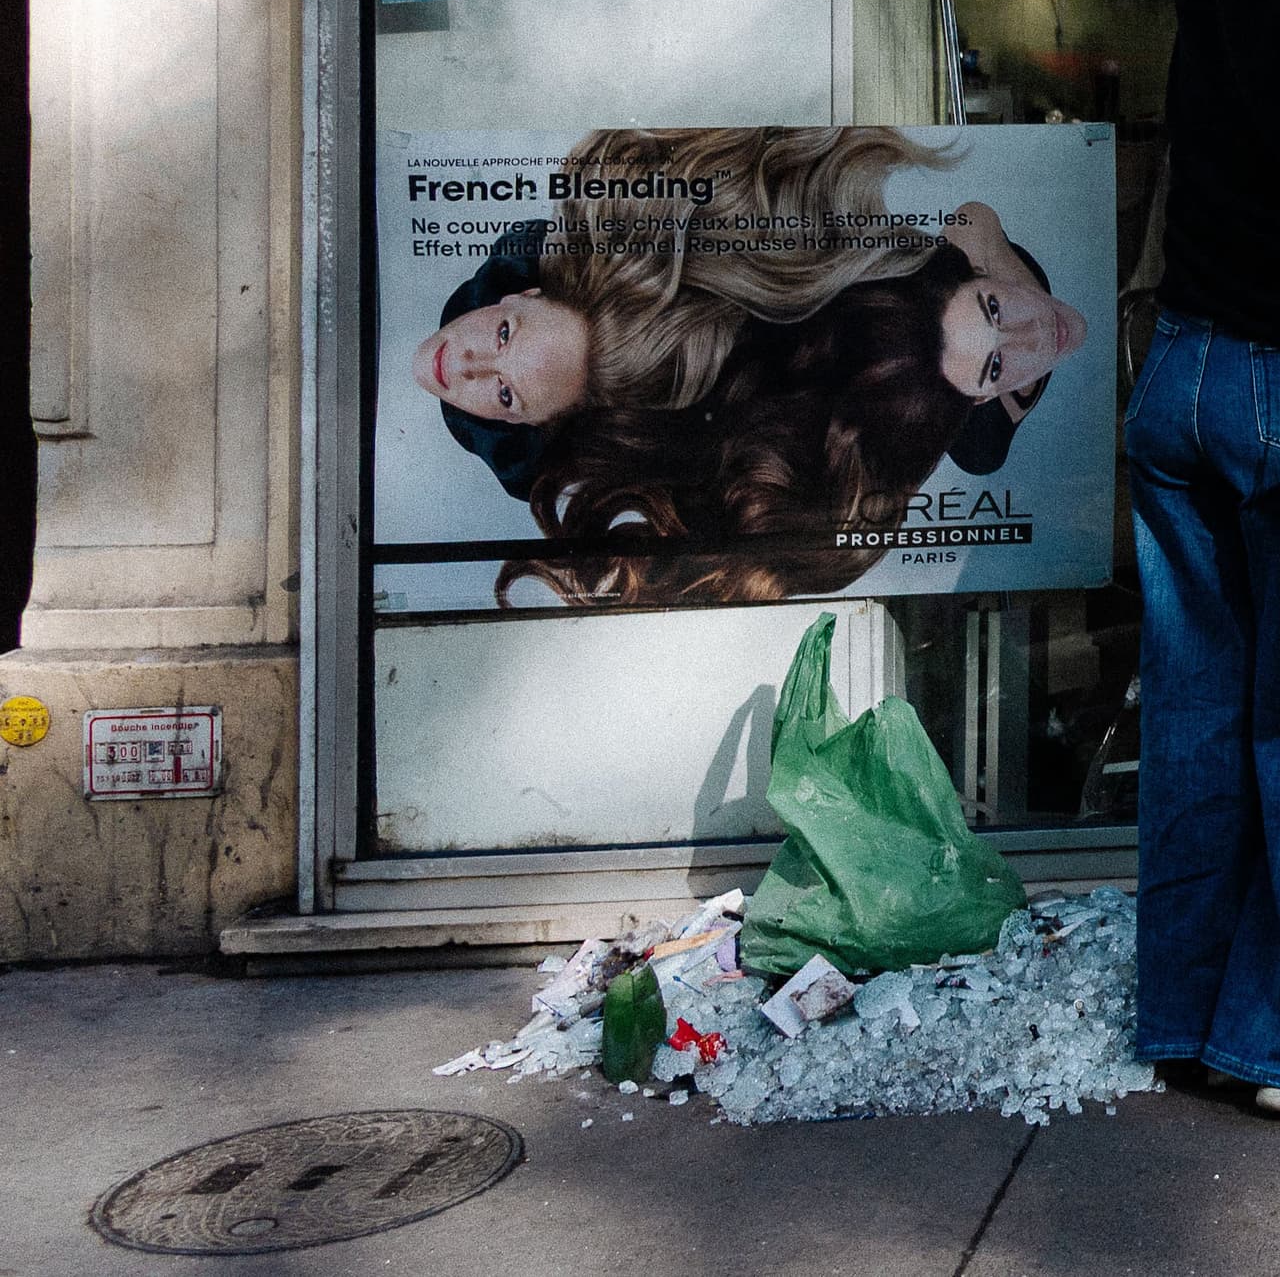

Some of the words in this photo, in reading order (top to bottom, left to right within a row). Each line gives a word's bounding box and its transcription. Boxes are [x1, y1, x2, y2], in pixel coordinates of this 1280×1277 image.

[407, 159, 421, 167] LA
[423, 158, 479, 167] NOUVELLE
[482, 157, 543, 166] APPROCHE
[546, 156, 569, 166] PRO
[408, 173, 538, 201] French
[412, 217, 441, 234] Ne
[446, 219, 537, 235] couvrez
[545, 216, 589, 239] plus
[596, 215, 627, 232] les
[631, 214, 728, 231] cheveux
[735, 213, 816, 231] blancs.
[823, 210, 973, 234] Estompez-les.
[413, 240, 463, 257] Effet
[468, 238, 681, 257] multidimensionnel.
[690, 236, 796, 257] Repousse
[835, 528, 1024, 547] PROFESSIONNEL
[901, 551, 957, 565] PARIS
[110, 724, 148, 733] Bouche
